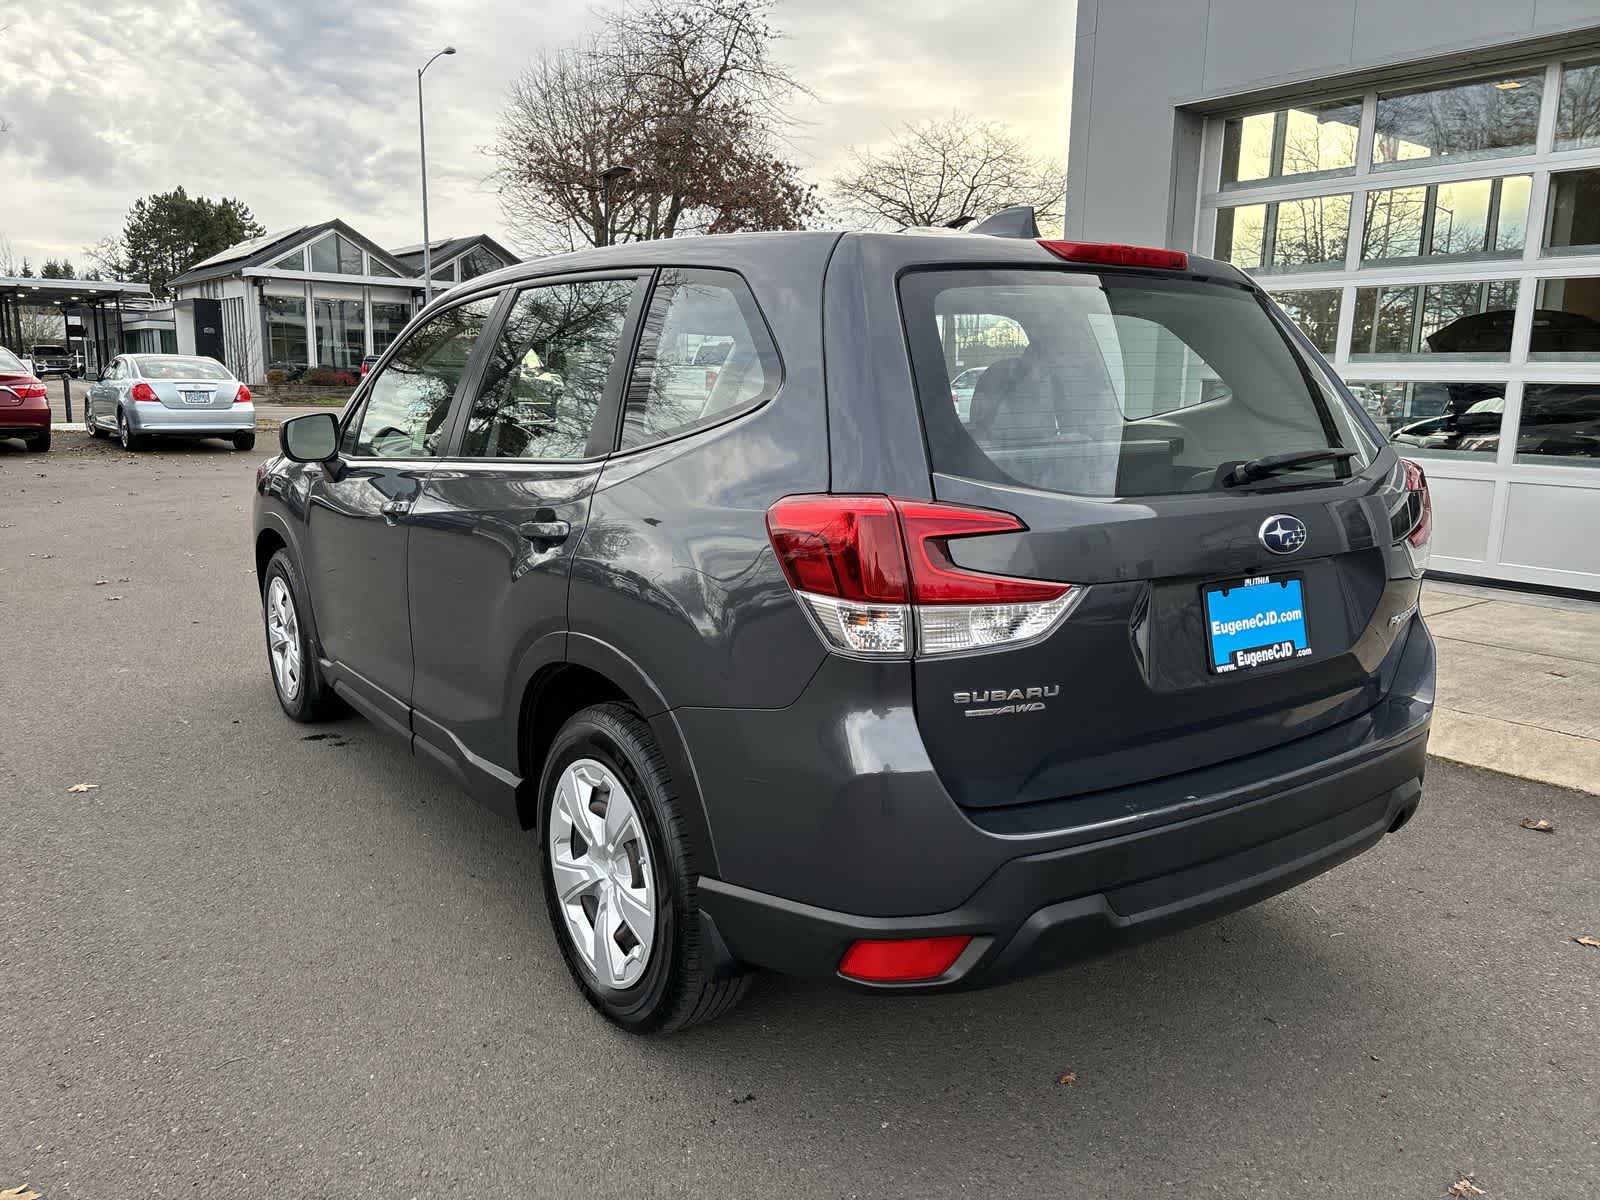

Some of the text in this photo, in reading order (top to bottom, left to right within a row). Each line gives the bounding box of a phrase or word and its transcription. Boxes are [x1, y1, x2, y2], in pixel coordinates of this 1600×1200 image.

[1211, 609, 1302, 636] EugeneCJD.com
[1216, 664, 1237, 673] www.
[1237, 642, 1292, 666] EugeneCJD
[953, 684, 1060, 704] SUBARU
[997, 702, 1046, 715] AWD
